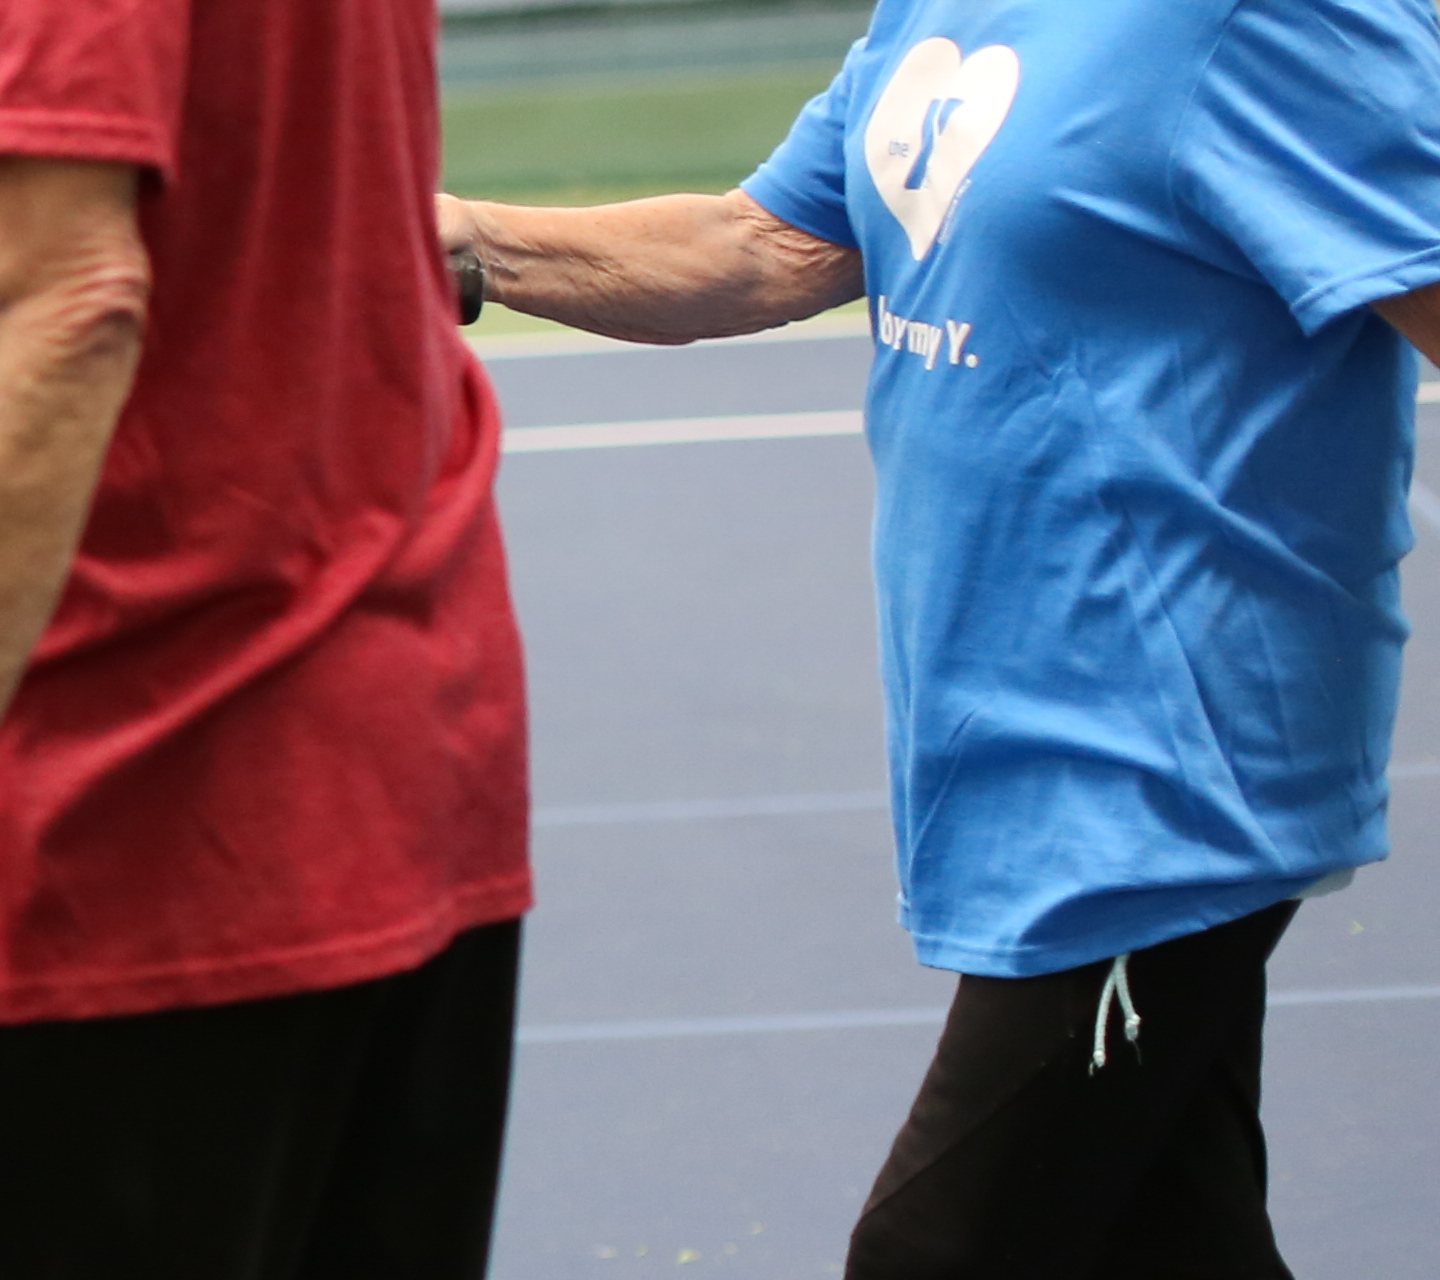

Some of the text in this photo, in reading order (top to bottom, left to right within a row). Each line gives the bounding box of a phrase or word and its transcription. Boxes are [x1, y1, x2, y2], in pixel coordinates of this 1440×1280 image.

[878, 294, 980, 371] by my Y.
